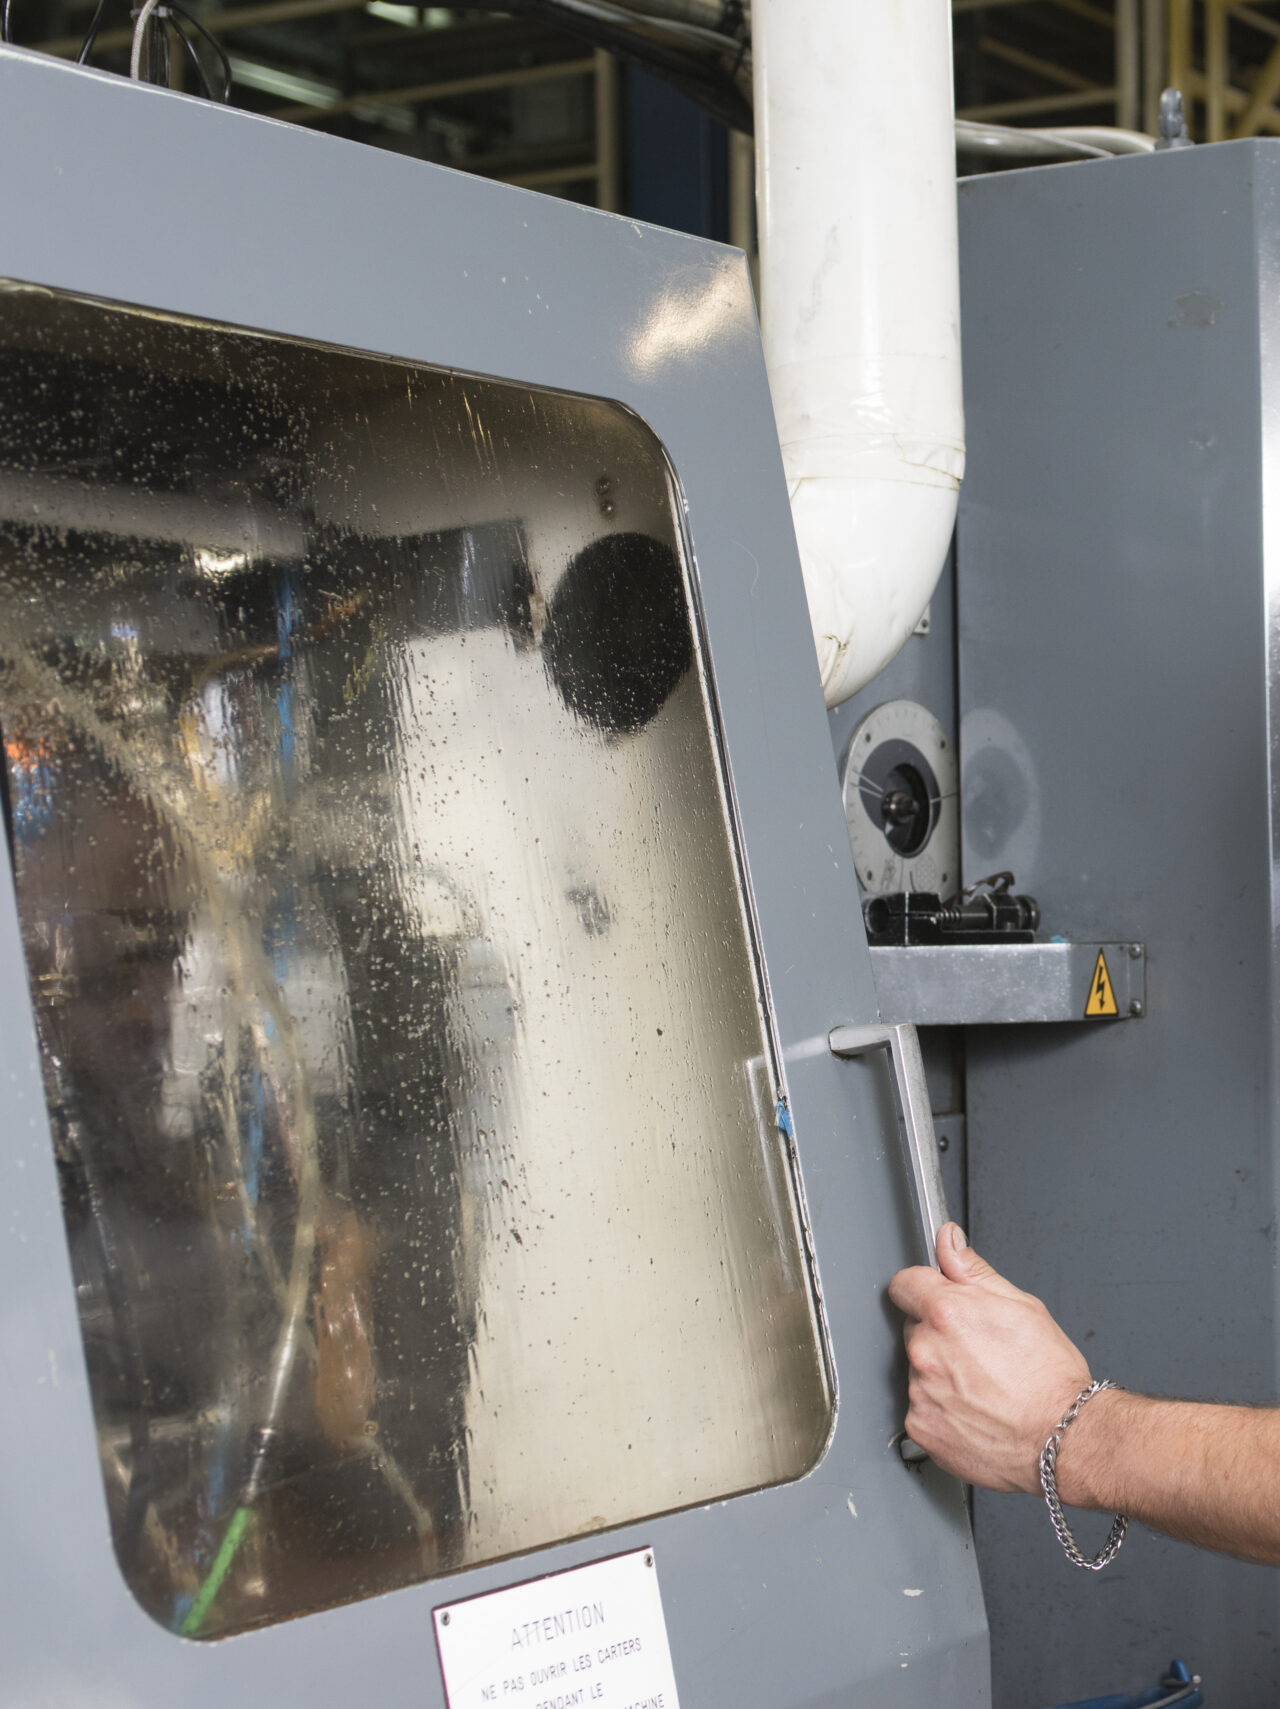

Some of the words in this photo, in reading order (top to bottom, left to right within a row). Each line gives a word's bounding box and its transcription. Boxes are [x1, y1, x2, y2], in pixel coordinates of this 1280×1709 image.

[512, 1601, 605, 1652] ATTENTION
[481, 1684, 497, 1702] NE
[503, 1676, 525, 1696] PAS
[530, 1661, 567, 1687] OUVRIR
[573, 1654, 592, 1672] LES
[597, 1637, 642, 1664] CARTERS
[591, 1682, 603, 1700] LE
